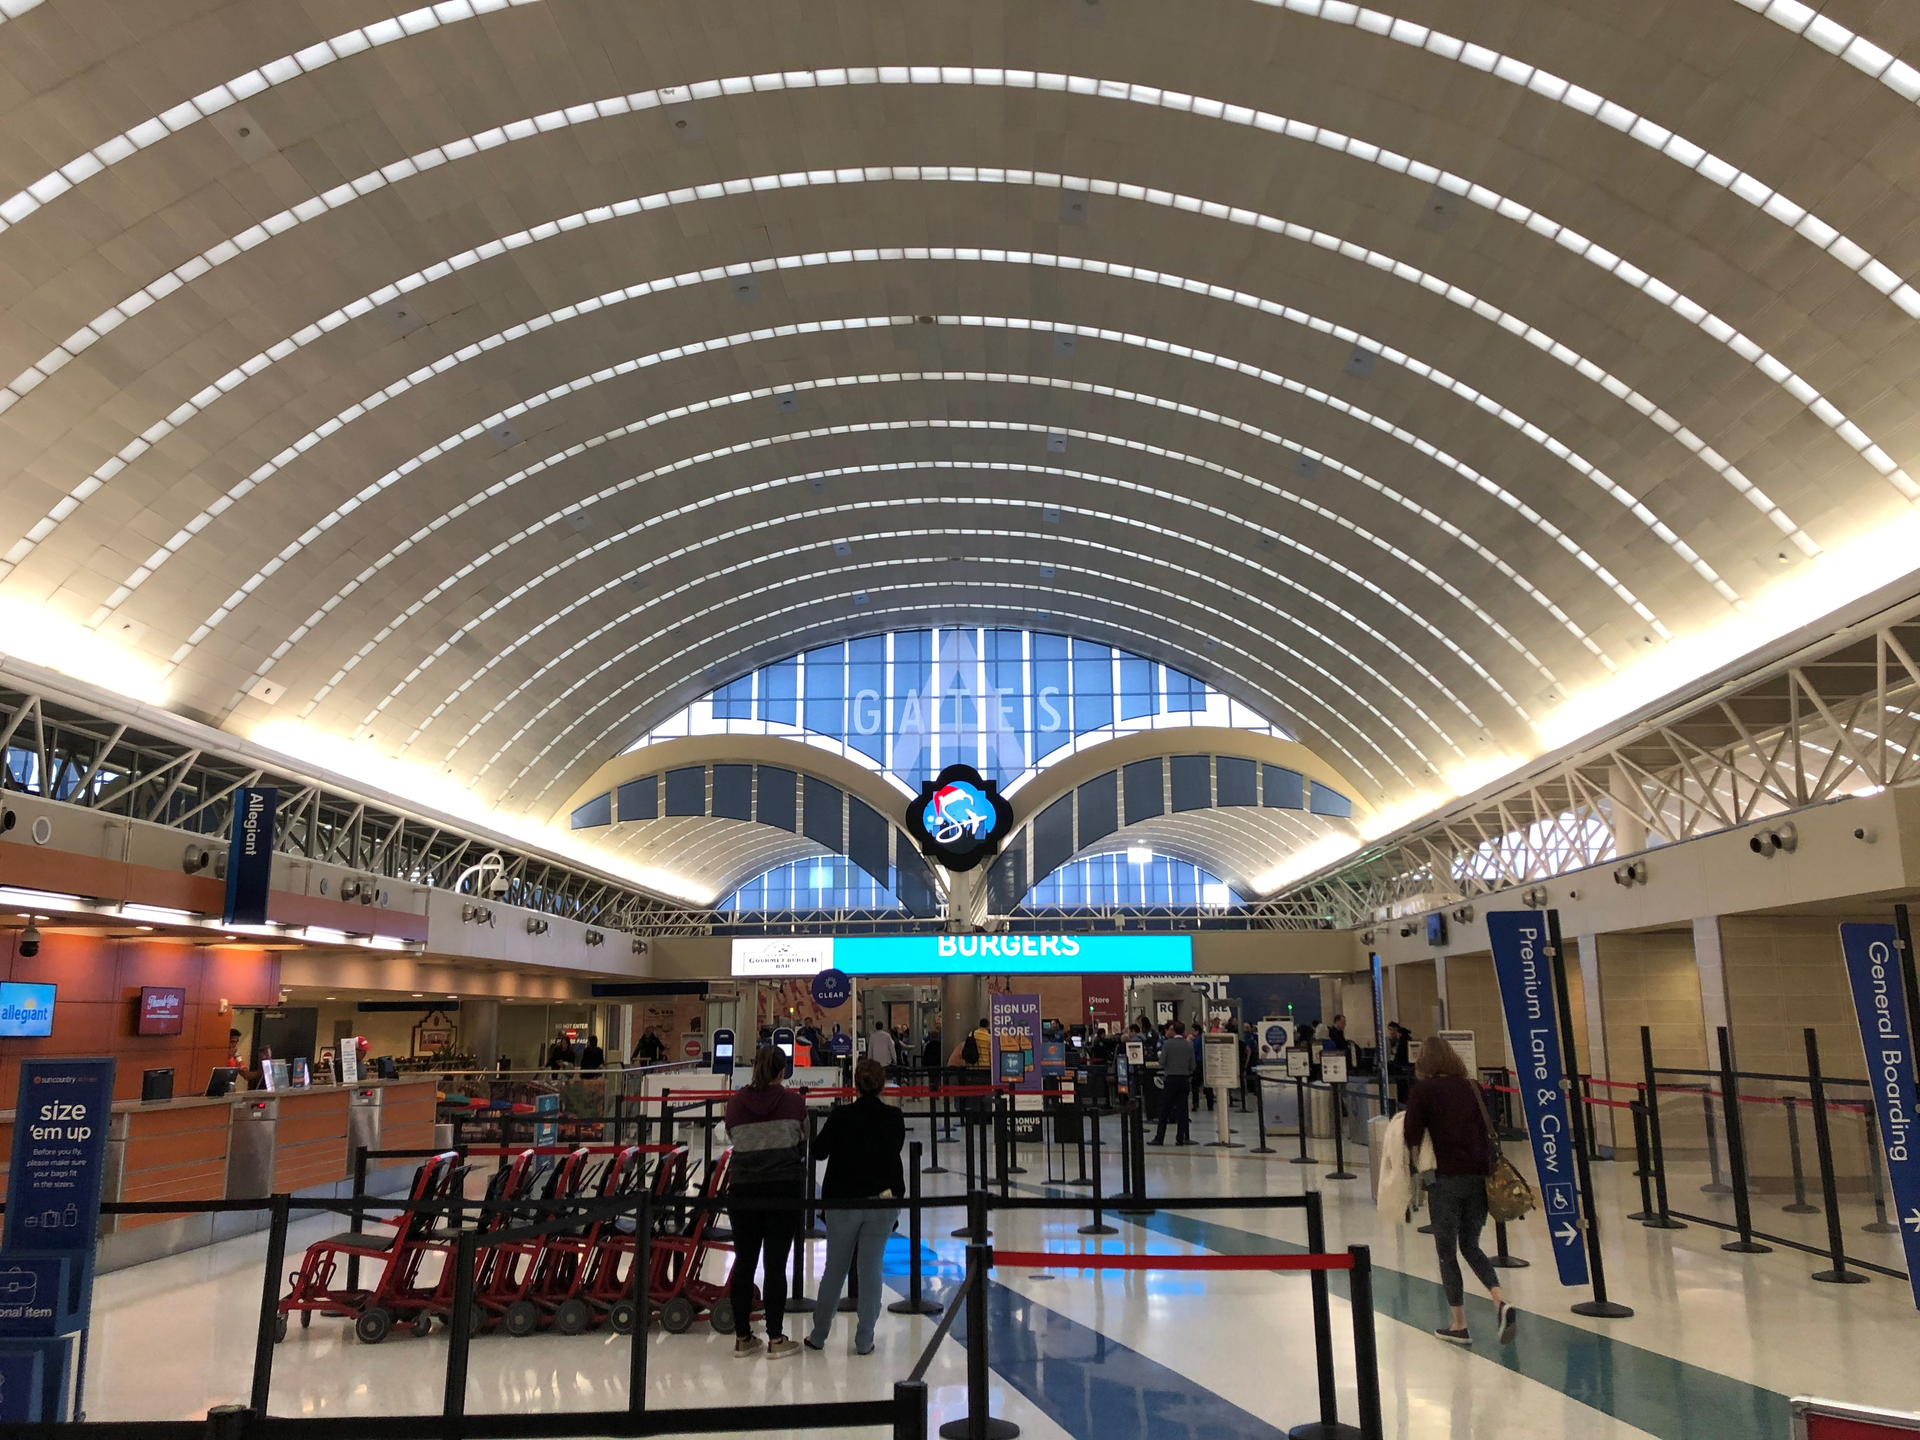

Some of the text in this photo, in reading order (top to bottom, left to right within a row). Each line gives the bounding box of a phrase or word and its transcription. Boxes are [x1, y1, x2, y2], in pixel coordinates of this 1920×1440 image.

[853, 686, 1062, 735] GATES
[243, 792, 265, 856] Allegiant
[938, 935, 1080, 957] BURGERS
[1, 1005, 48, 1025] allegiant
[993, 1003, 1038, 1014] SIGN UP.
[994, 1015, 1013, 1025] SIP.
[994, 1026, 1034, 1037] SCORE.
[1518, 927, 1561, 1173] Premium Lane & Crew
[1868, 941, 1911, 1161] General Boarding
[40, 1100, 87, 1121] size
[66, 1126, 91, 1142] up
[33, 1148, 56, 1156] Before
[57, 1149, 71, 1157] you
[27, 1159, 50, 1167] please
[50, 1170, 68, 1178] bags
[25, 1306, 52, 1318] item
